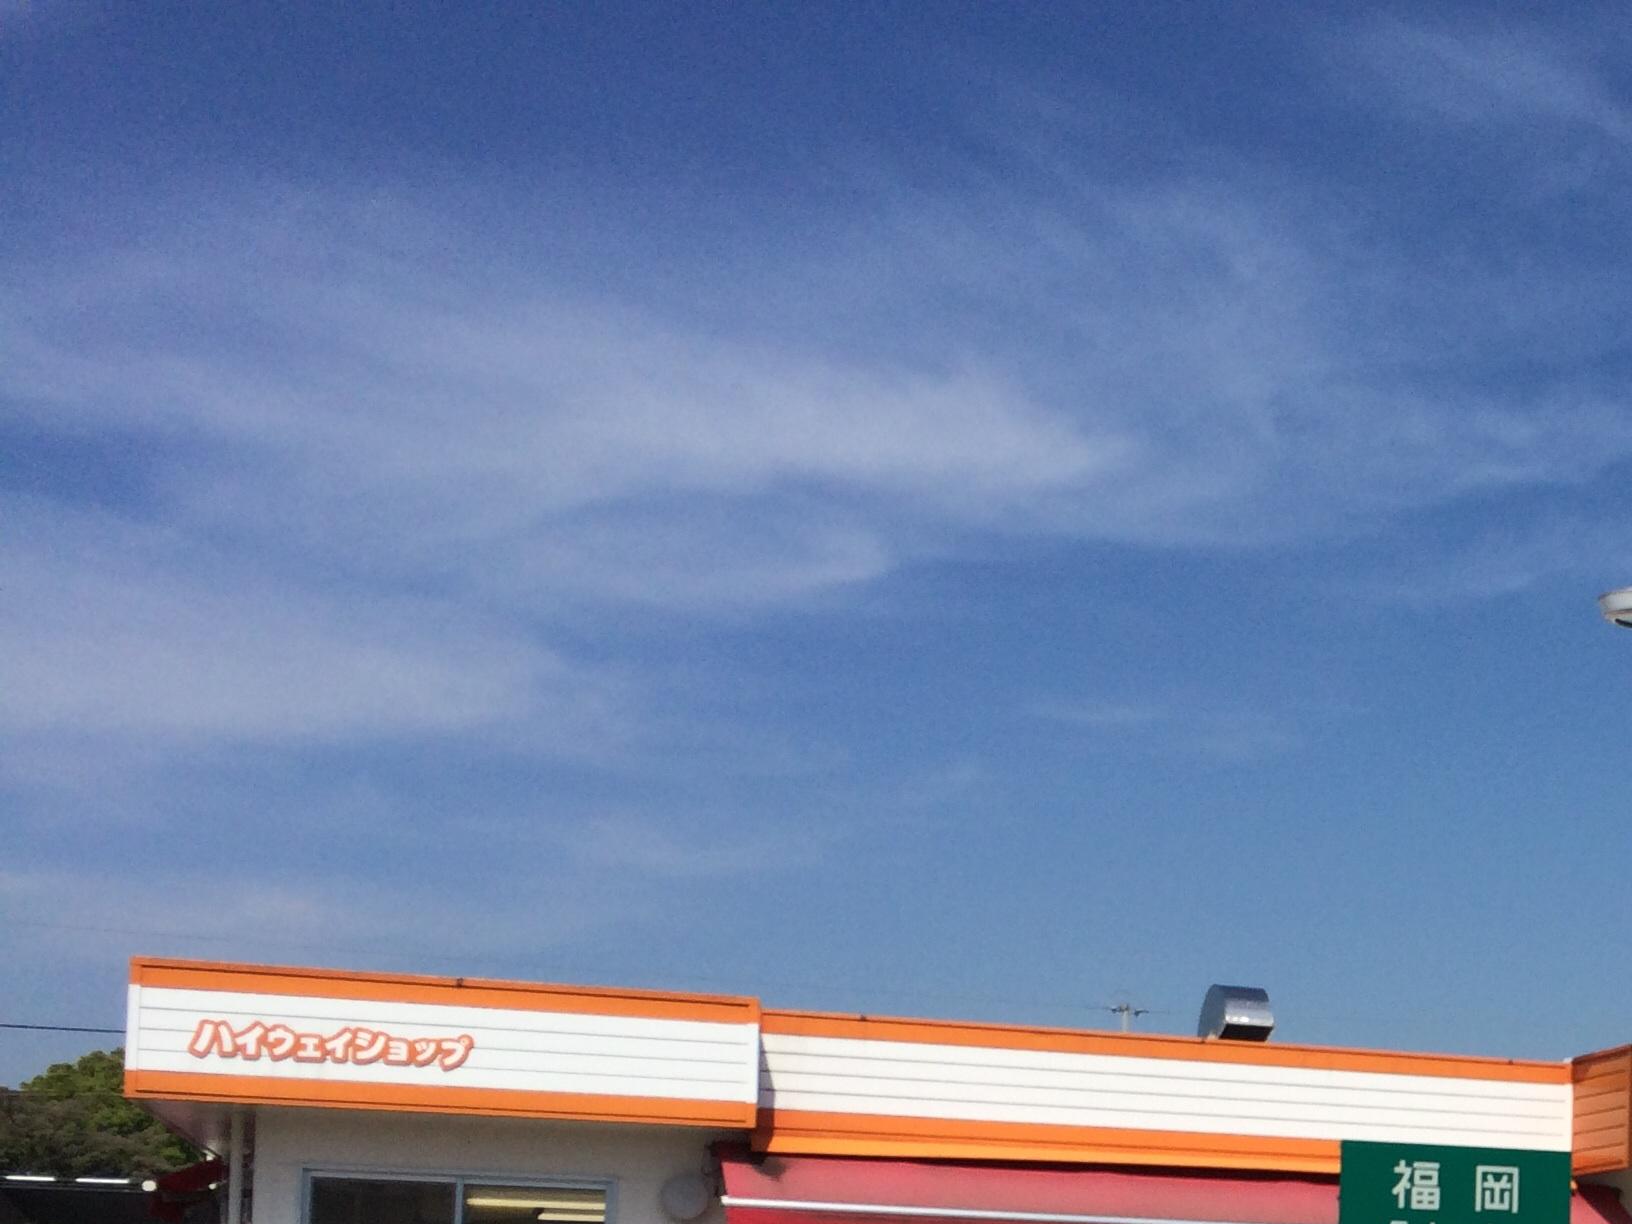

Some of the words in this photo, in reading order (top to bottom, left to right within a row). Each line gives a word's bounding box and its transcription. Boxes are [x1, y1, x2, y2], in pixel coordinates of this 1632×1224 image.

[188, 1018, 475, 1072] ハイウェイショップ
[1392, 1159, 1519, 1213] 福岡
